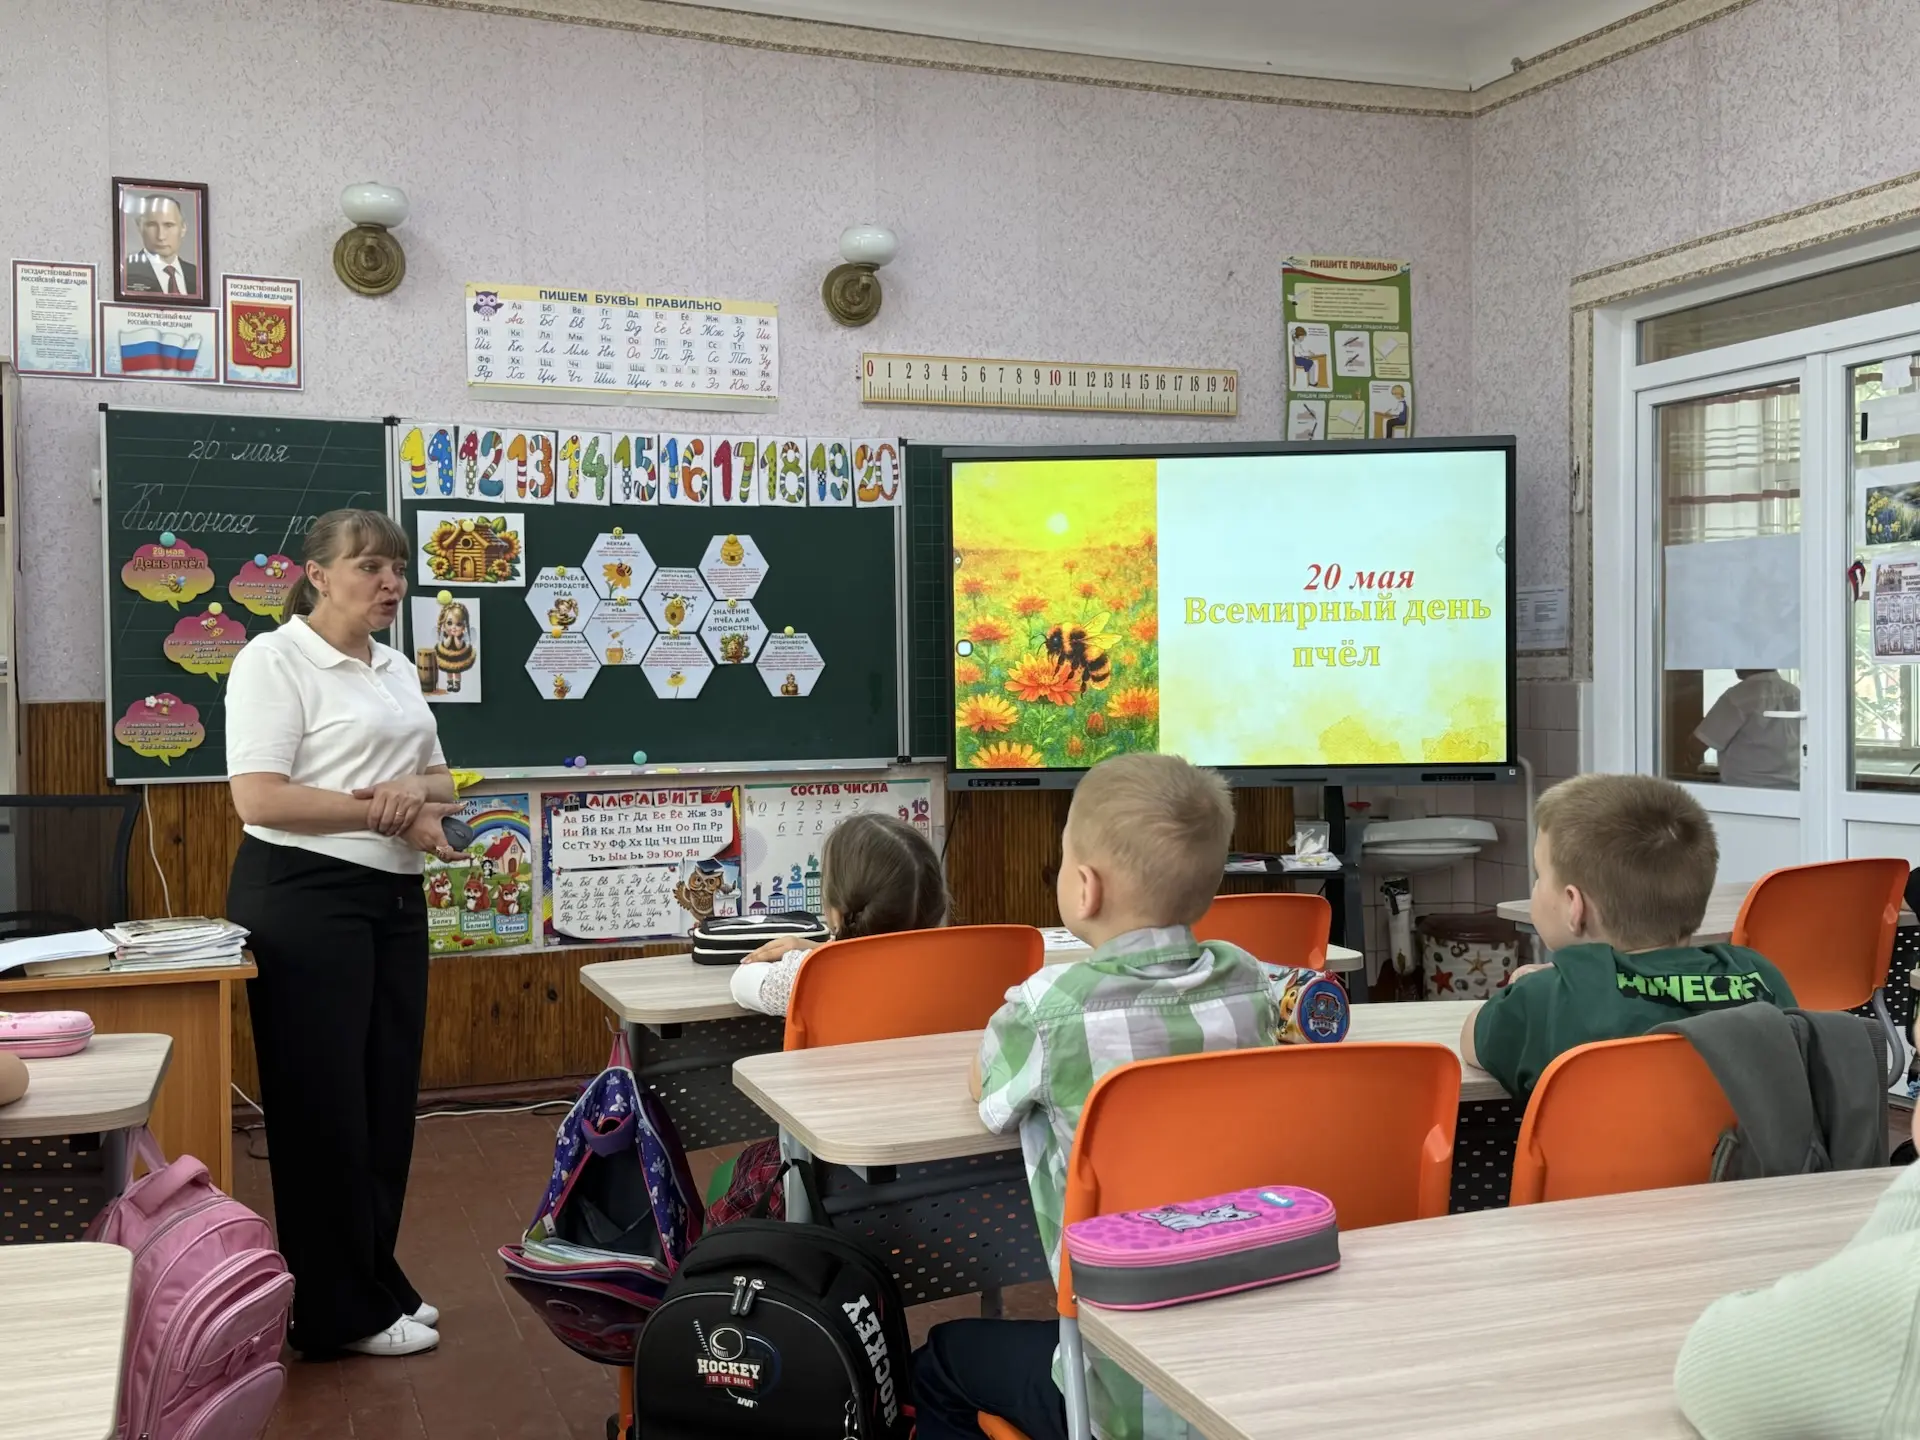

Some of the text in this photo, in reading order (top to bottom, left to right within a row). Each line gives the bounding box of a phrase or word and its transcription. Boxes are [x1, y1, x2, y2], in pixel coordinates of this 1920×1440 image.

[1310, 259, 1398, 272] ПИШИТЕ ПРАВИЛЬНО
[539, 290, 722, 311] ПИШЕМ БУКВЫ ПРАВИЛЬНО
[867, 360, 1234, 392] 0 1 2 3 4 5 6 7 8 9 10 11 12 13 14 15 16 17 18 19 20
[188, 440, 290, 462] 20 мая
[401, 428, 898, 503] 11 12 13 14 15 16 17 18 19 20
[122, 483, 259, 534] Классная
[152, 547, 186, 557] 20 мая
[134, 556, 204, 572] День пчёл
[1304, 564, 1414, 591] 20 мая
[1184, 592, 1492, 630] Всемирный день
[1293, 639, 1380, 669] пчёл
[790, 782, 889, 796] СОСТАВ ЧИСЛА
[588, 792, 699, 808] АЛФАВИТ
[759, 798, 858, 811] 0 1 2 3 4 5
[912, 800, 929, 814] 10
[564, 816, 577, 824] Аа
[582, 814, 595, 823] Бб
[600, 814, 613, 822] Вв
[618, 813, 629, 821] Гг
[633, 813, 647, 822] Дд
[653, 812, 665, 820] Ее
[670, 809, 683, 818] Ёё
[687, 810, 706, 818] Жж
[563, 822, 723, 837] Ии Йй Кк Лл Мм Нн Оо Пп Рр
[778, 820, 822, 832] 6 7 8
[563, 835, 723, 850] Сс Тт Уу Фф Хх Цц Чч Шш Щщ
[589, 849, 699, 862] Ъъ Ыы Ьь Ээ Юю Яя
[808, 854, 819, 871] 4
[790, 865, 802, 882] 3
[772, 876, 782, 892] 2
[752, 884, 762, 901] 1
[697, 1358, 760, 1380] HOCKEY
[842, 1294, 898, 1428] HOCKEY
[722, 1376, 732, 1384] THE
